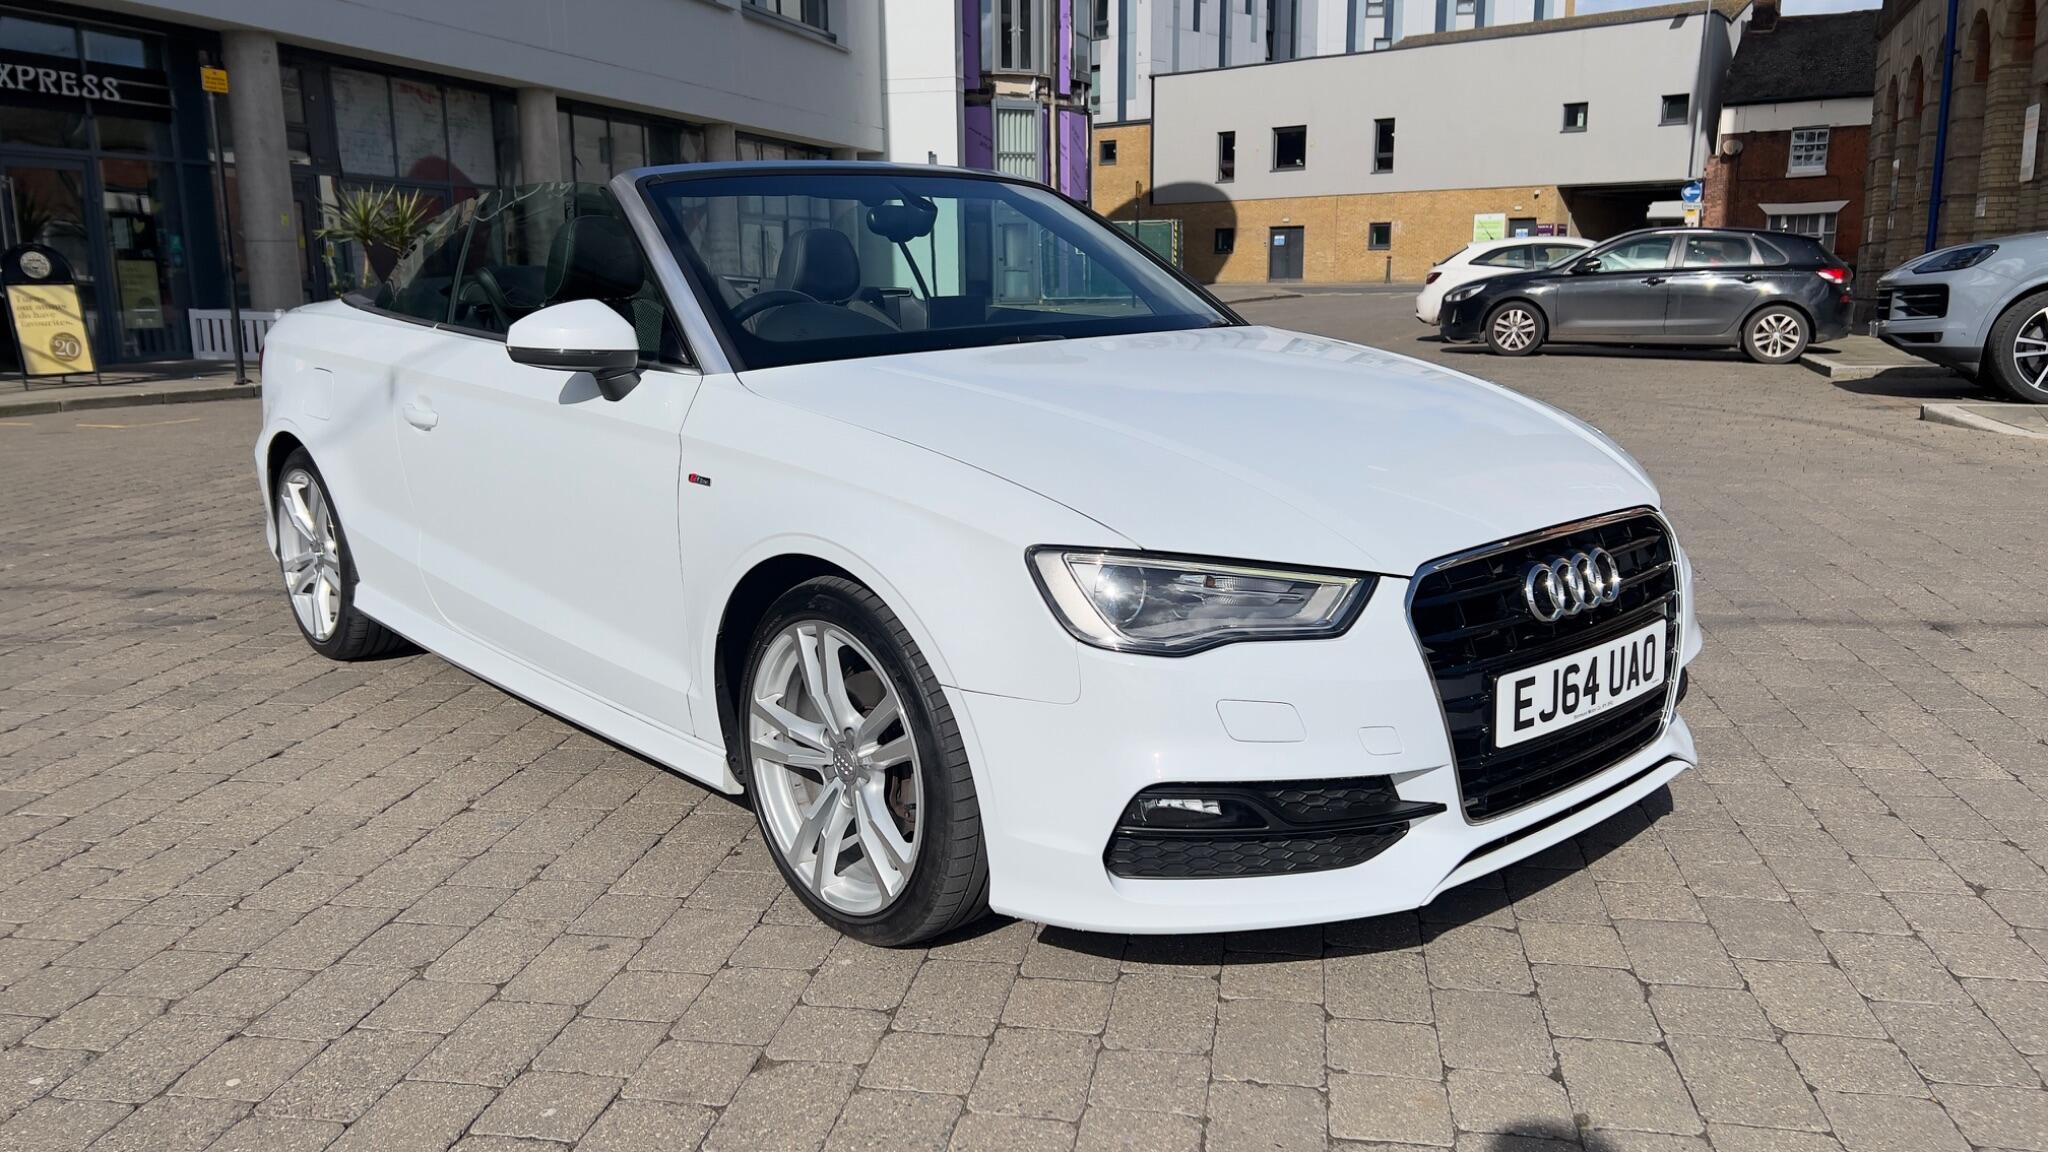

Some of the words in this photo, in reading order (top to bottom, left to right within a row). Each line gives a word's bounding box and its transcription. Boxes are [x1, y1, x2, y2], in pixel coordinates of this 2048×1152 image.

[0, 63, 120, 101] XPRESS
[54, 339, 80, 359] 20
[1513, 655, 1600, 732] EJ64
[1608, 633, 1656, 697] UAO
